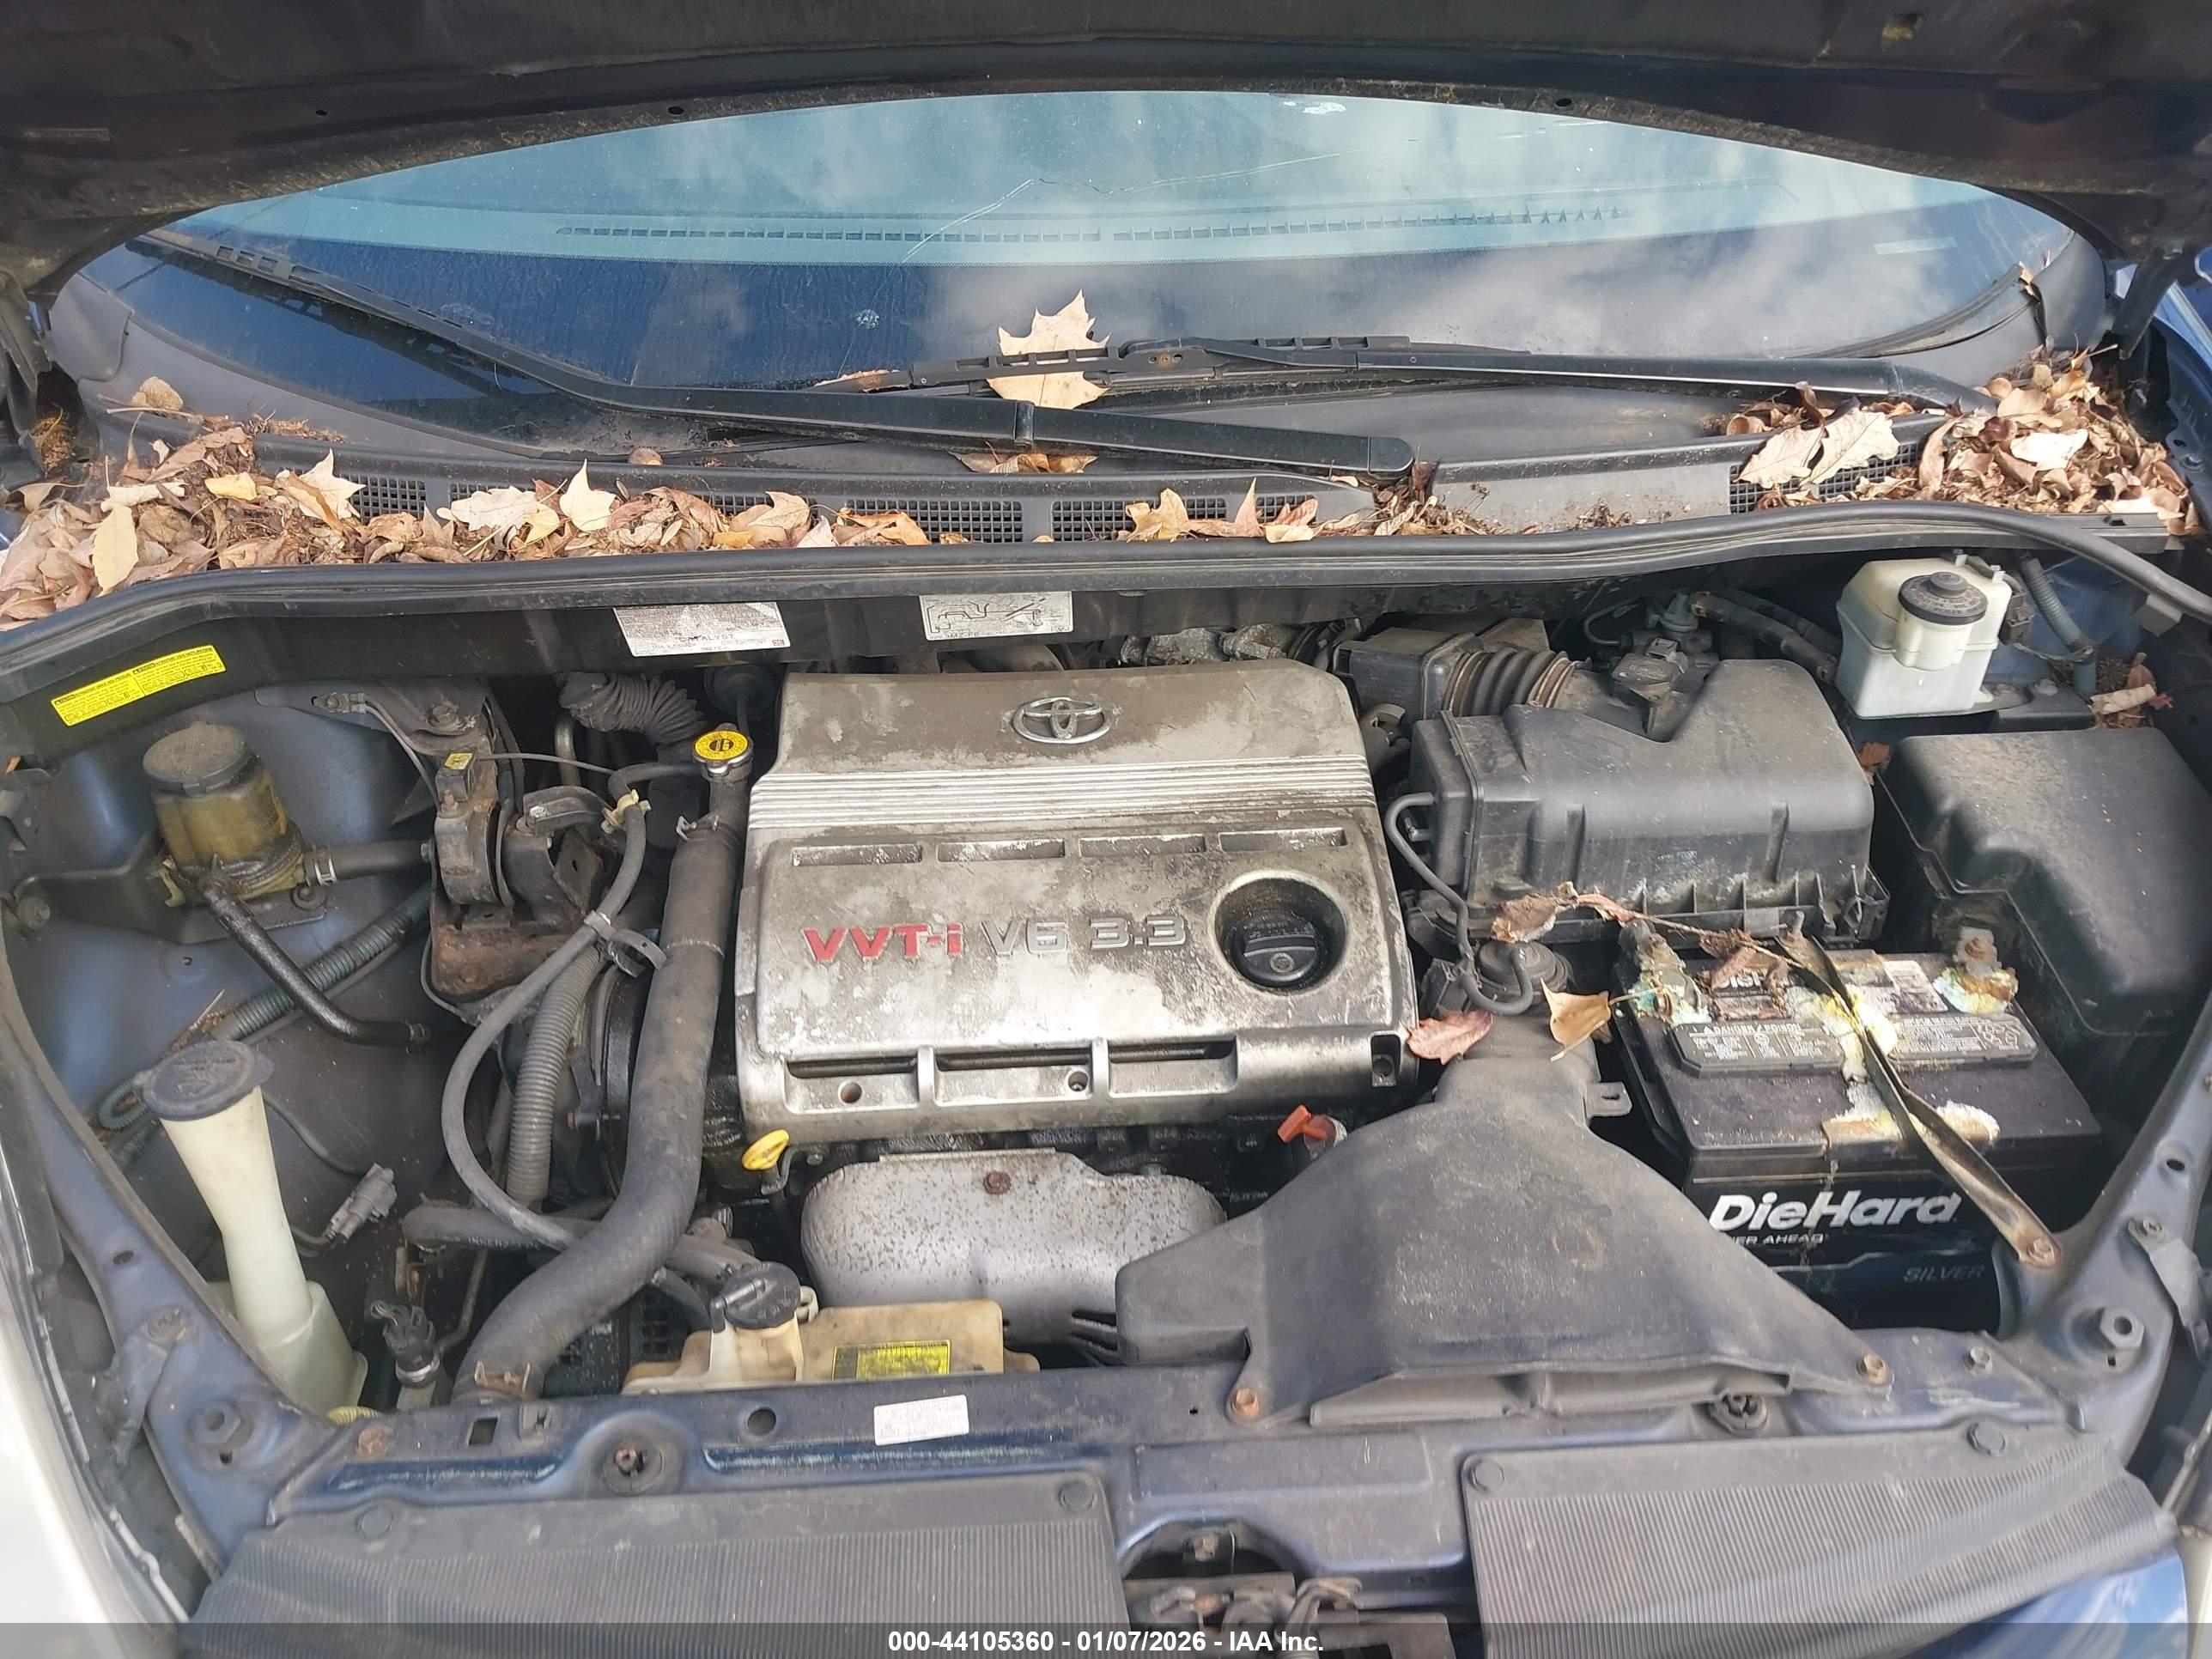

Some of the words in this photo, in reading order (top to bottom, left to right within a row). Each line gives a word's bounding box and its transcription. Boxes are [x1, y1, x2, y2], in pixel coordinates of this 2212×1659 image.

[802, 921, 963, 962] VVT-i
[980, 918, 1067, 956] V6
[1090, 915, 1186, 950] 3.3
[1709, 1190, 1962, 1231] DieHard
[1763, 1234, 1824, 1244] AHEAD
[1904, 1265, 1985, 1283] SILVER
